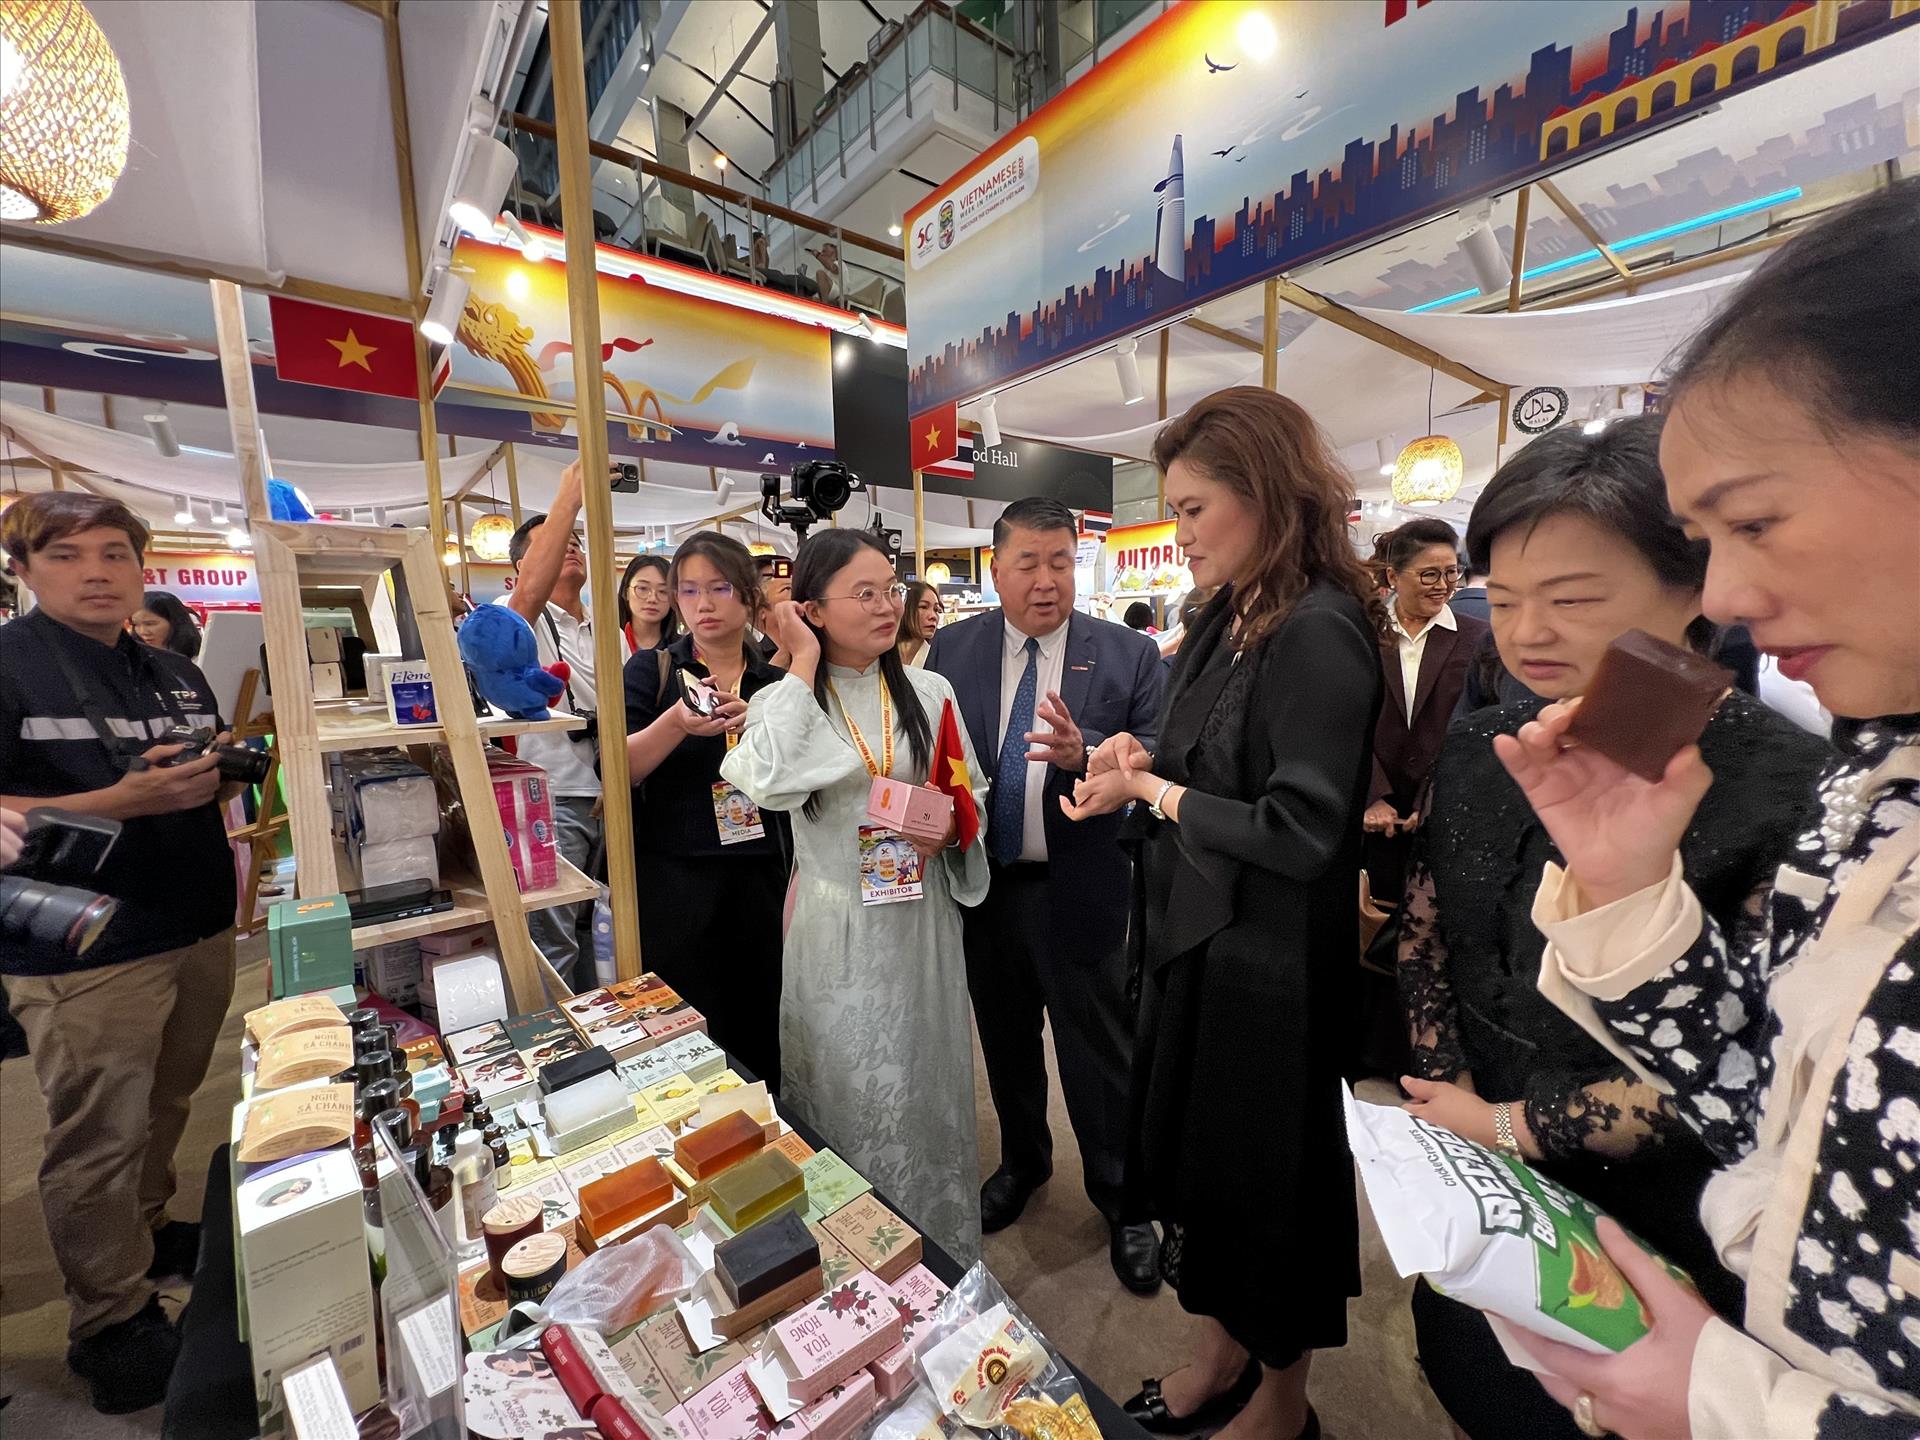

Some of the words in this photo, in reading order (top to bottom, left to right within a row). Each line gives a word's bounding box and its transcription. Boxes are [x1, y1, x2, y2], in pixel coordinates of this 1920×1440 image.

[960, 160, 1017, 209] VIETNAMESE
[960, 206, 975, 219] WEEK
[977, 199, 984, 208] IN
[985, 175, 1018, 200] THAILAND
[991, 449, 1019, 468] Hall
[177, 568, 248, 586] GROUP
[870, 886, 913, 898] EXHIBITOR
[790, 1315, 823, 1342] HỒNG
[803, 1333, 831, 1357] HOA
[707, 1391, 732, 1419] HOA
